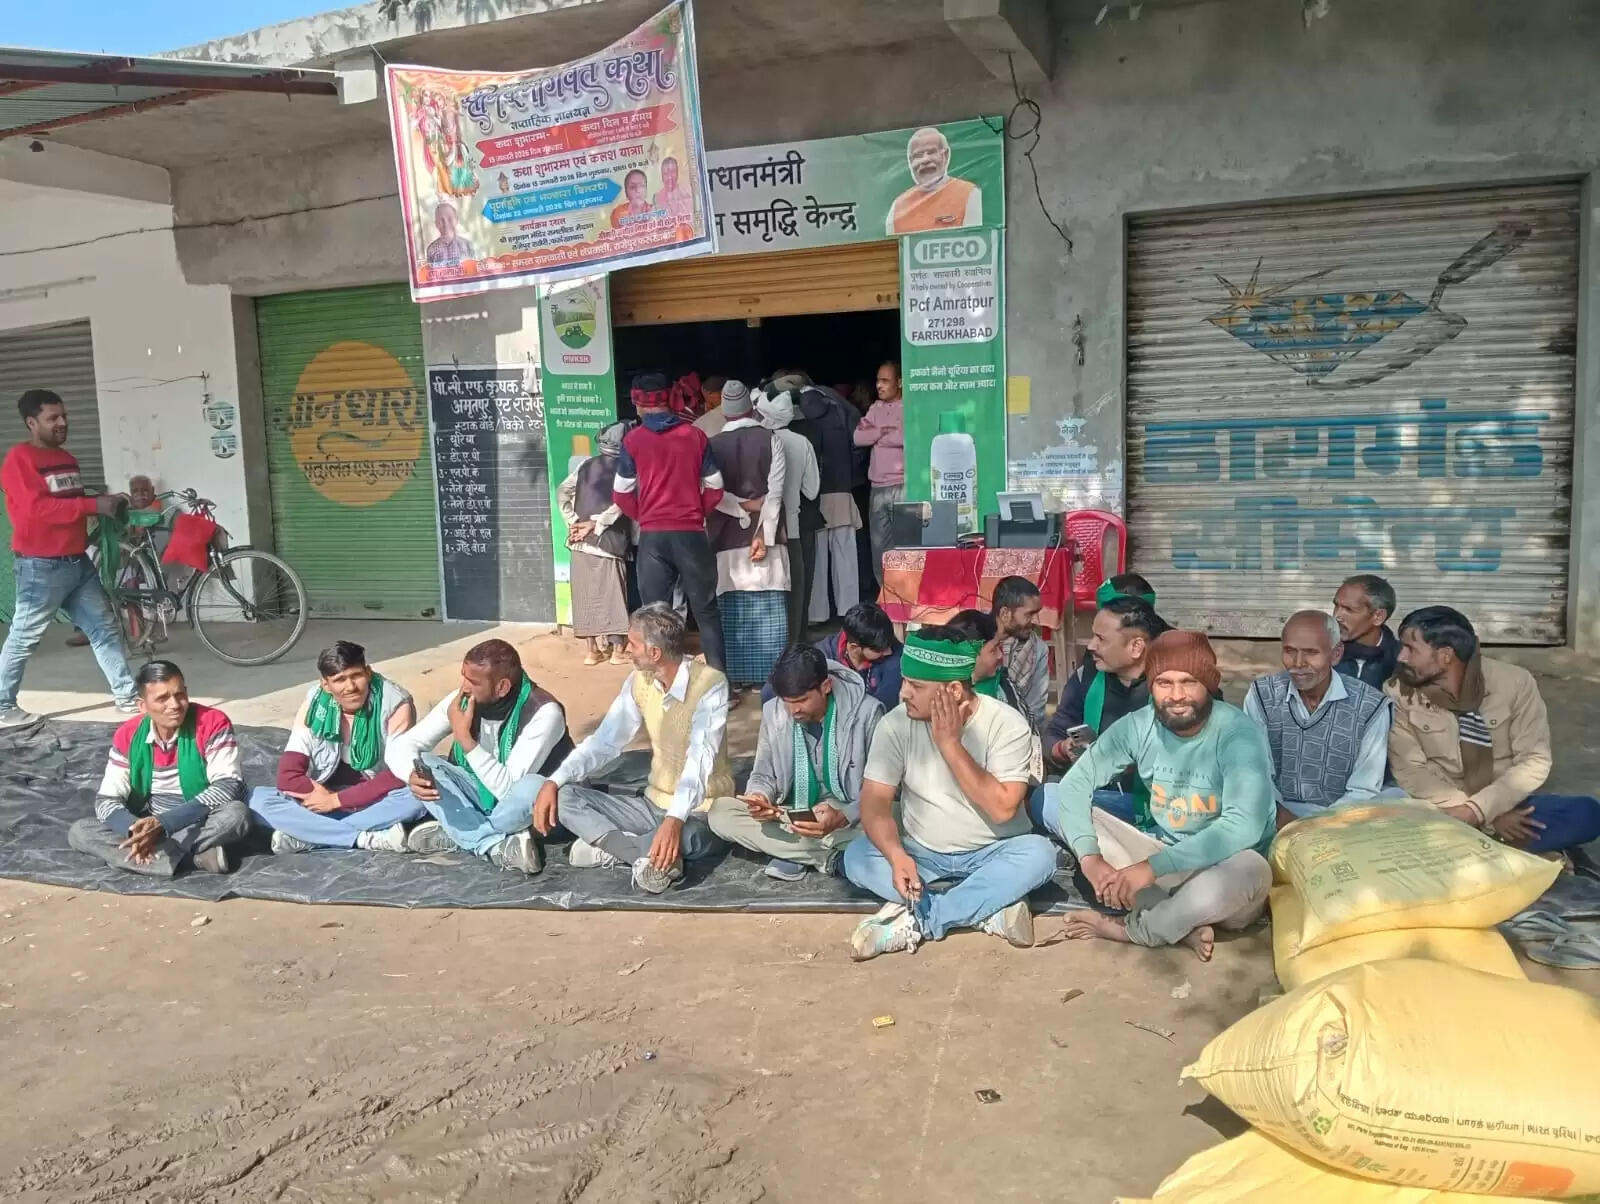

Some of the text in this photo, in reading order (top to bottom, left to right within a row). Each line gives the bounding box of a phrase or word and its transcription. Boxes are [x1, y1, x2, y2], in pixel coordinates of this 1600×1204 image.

[603, 49, 676, 99] कथा
[513, 165, 532, 178] कथा
[535, 158, 570, 177] शुभारम्भ
[572, 152, 587, 166] एवं
[588, 149, 617, 164] कलश
[708, 150, 805, 192] धानमंत्री
[731, 198, 799, 242] समृद्धि
[803, 195, 857, 232] केन्द्र
[922, 240, 980, 260] IFFCO
[910, 295, 994, 312] Pcf Amratpur
[928, 316, 965, 328] 271298
[912, 327, 992, 341] FARRUKHABAD
[486, 379, 519, 398] कृषक
[451, 398, 492, 419] अमृतपुर
[494, 398, 512, 415] एट
[450, 431, 476, 447] यूरिया
[941, 491, 967, 500] UREA
